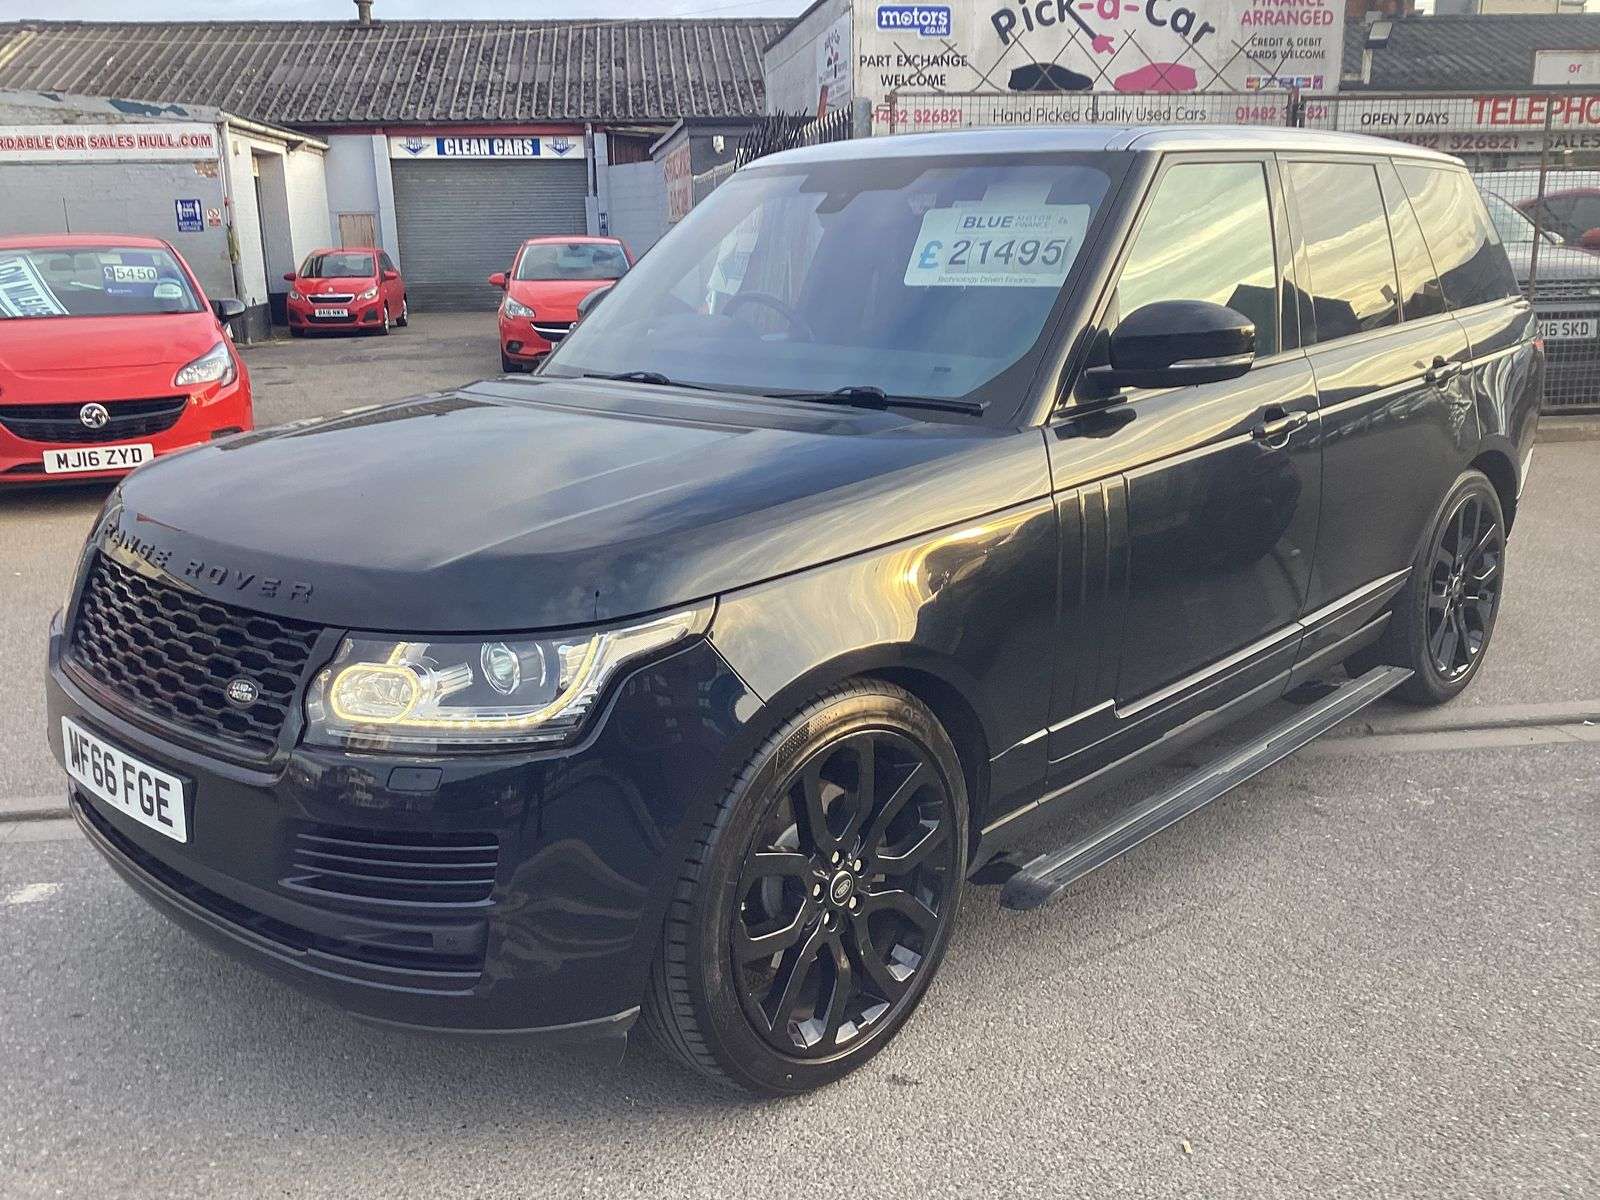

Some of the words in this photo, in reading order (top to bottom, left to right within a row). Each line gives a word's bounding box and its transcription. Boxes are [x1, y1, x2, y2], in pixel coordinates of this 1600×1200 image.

[881, 8, 947, 25] motors
[991, 0, 1215, 45] Pick-a-Car
[1241, 10, 1333, 26] ARRANGED
[923, 26, 947, 34] .co.uk
[1252, 37, 1283, 47] CREDIT
[1287, 37, 1294, 47] &
[1297, 37, 1322, 47] DEBIT
[860, 55, 892, 67] PART
[897, 55, 968, 67] EXCHANGE
[1246, 50, 1277, 59] CARDS
[1281, 50, 1326, 59] WELCOME
[1568, 64, 1583, 73] or
[881, 74, 946, 86] WELCOME
[914, 109, 963, 123] 326821
[993, 107, 1032, 123] Hand
[1036, 107, 1080, 123] Picked
[1085, 107, 1132, 124] Quality
[1136, 107, 1171, 123] Used
[1175, 107, 1207, 121] Cars
[1235, 106, 1277, 121] 01482
[1361, 112, 1398, 125] OPEN
[1404, 112, 1411, 125] 7
[1415, 112, 1449, 125] DAYS
[57, 135, 85, 148] CAR
[90, 134, 134, 148] SALES
[139, 133, 212, 147] HULL.COM
[443, 138, 490, 155] CLEAN
[493, 138, 533, 155] CARS
[1450, 132, 1520, 150] 326821
[963, 215, 1014, 228] BLUE
[1562, 321, 1589, 336] SKD
[57, 452, 100, 469] MJ16
[106, 448, 142, 466] ZYD
[105, 523, 172, 568] RANGE
[185, 560, 313, 604] ROVER
[121, 759, 174, 828] FGE
